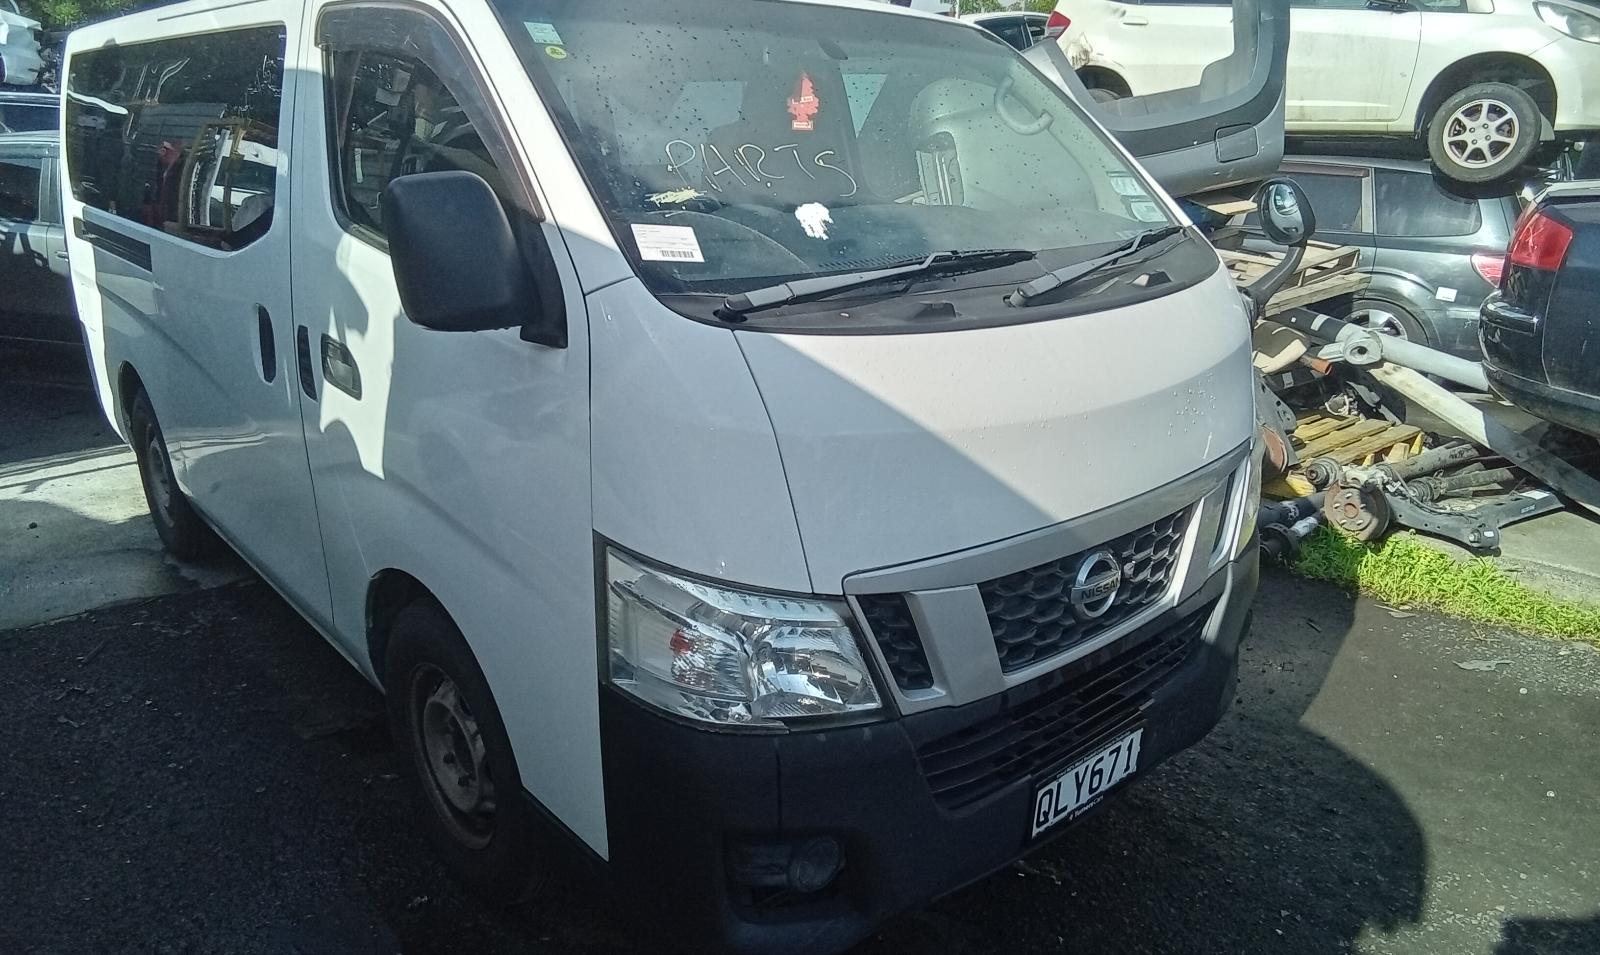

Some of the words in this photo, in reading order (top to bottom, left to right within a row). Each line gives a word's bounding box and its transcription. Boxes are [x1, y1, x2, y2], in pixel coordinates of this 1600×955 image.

[665, 140, 857, 197] PARTS
[1081, 577, 1119, 599] NISSAN
[1035, 738, 1134, 829] QLY671
